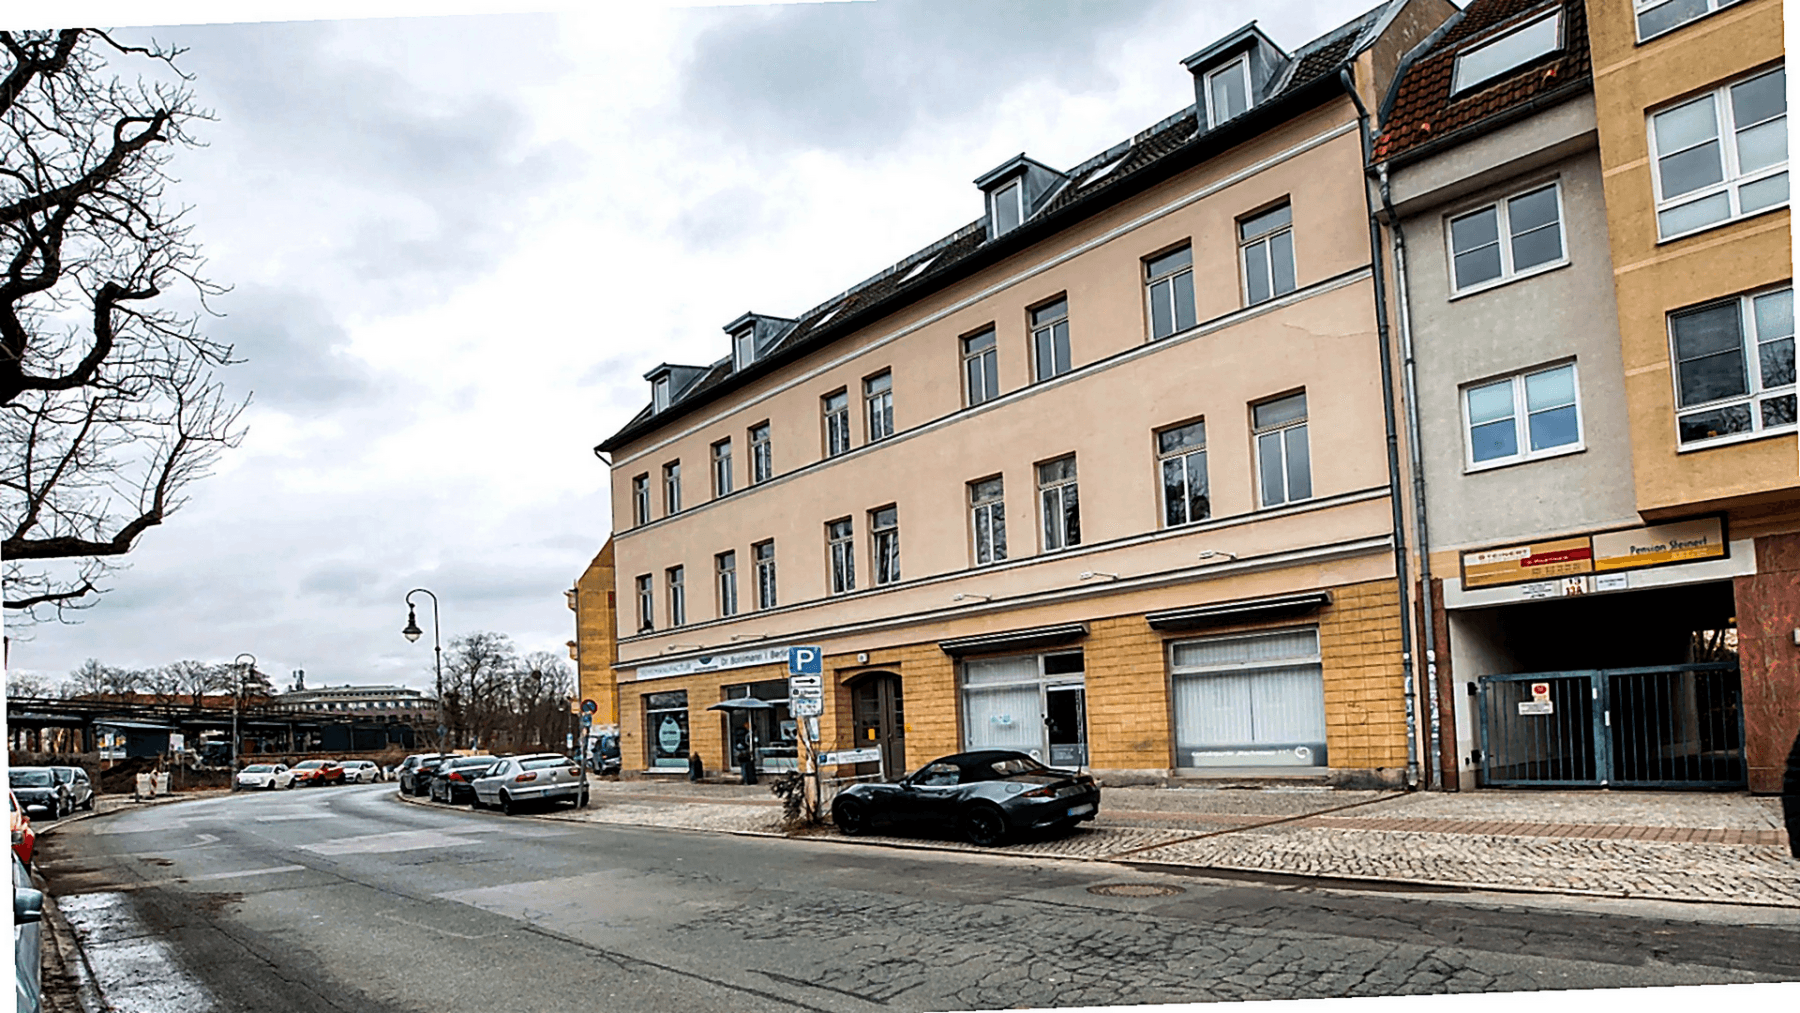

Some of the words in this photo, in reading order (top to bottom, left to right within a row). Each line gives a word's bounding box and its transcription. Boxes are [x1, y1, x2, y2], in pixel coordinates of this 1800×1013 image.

[1629, 544, 1667, 555] Pension
[1669, 535, 1708, 549] Steinert
[797, 650, 815, 671] P
